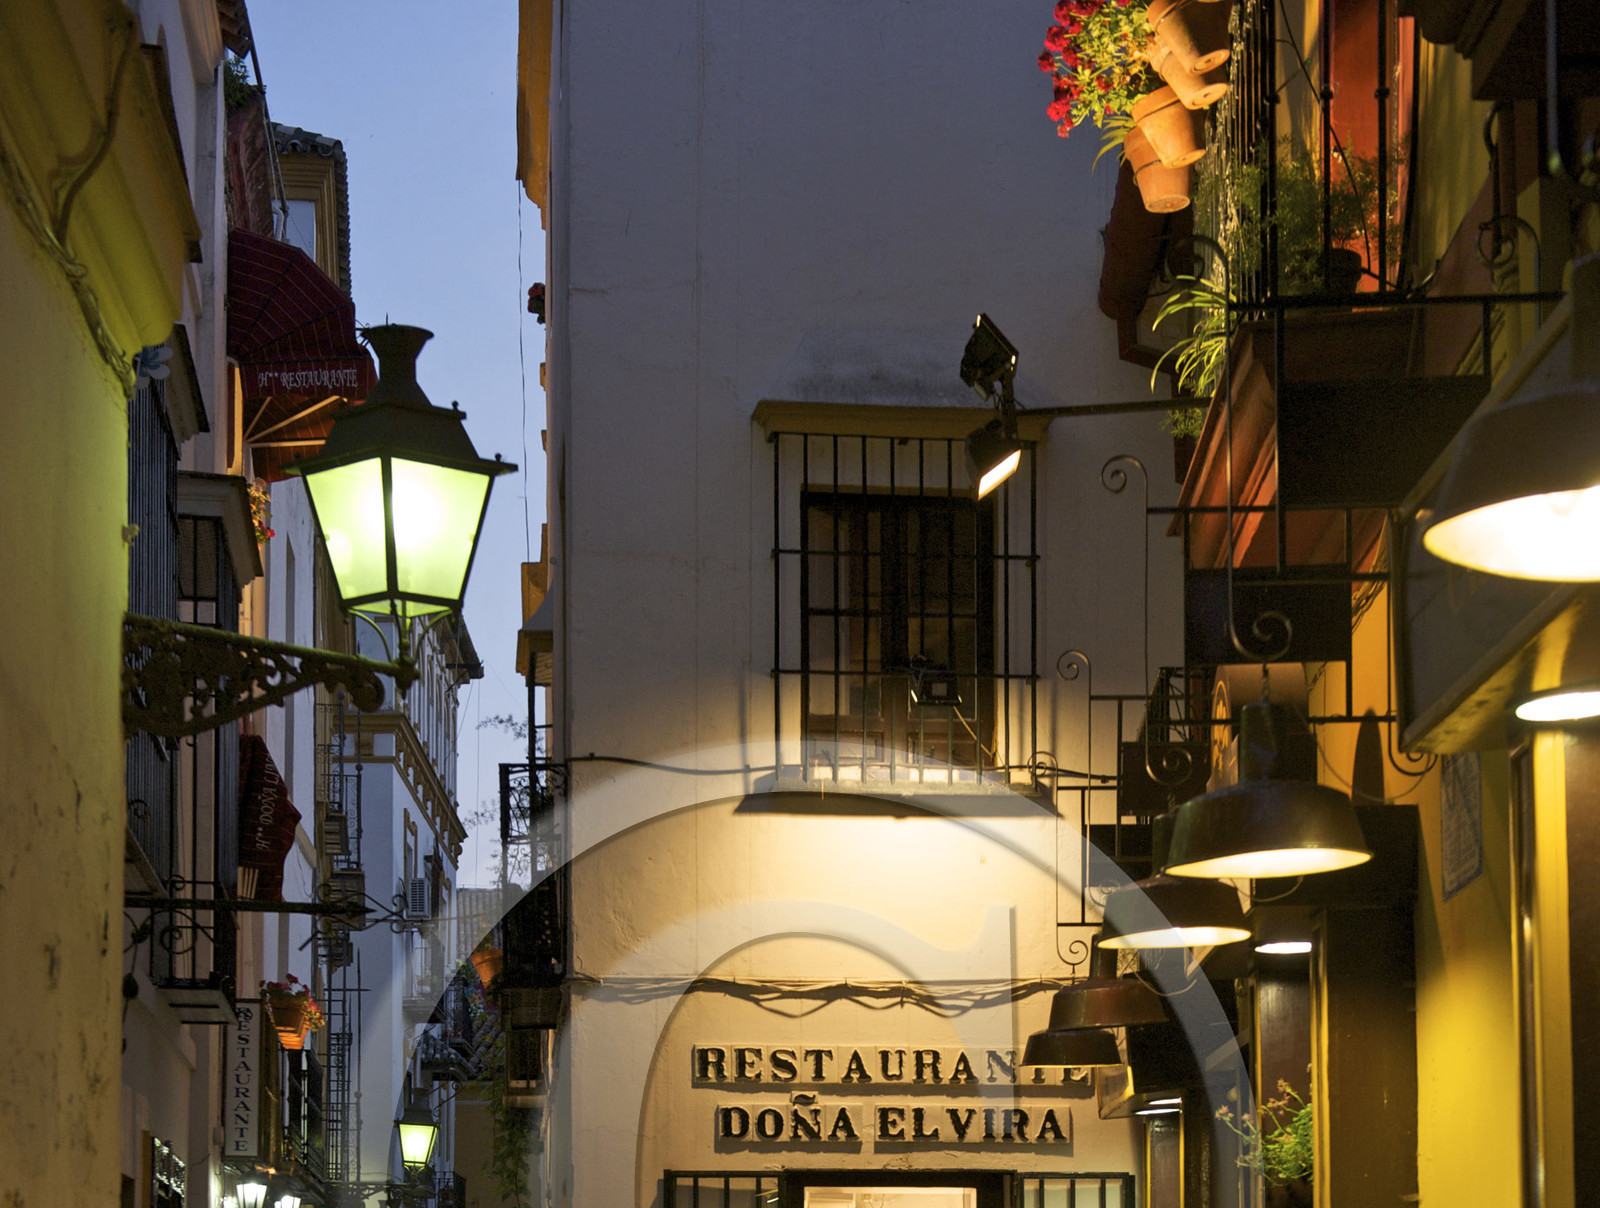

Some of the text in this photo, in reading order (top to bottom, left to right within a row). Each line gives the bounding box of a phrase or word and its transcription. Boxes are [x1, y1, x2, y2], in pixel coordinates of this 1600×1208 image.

[281, 368, 358, 389] RESTAURANTE
[258, 787, 278, 825] DOÑA
[719, 1092, 1067, 1141] DOÑA ELVIRA
